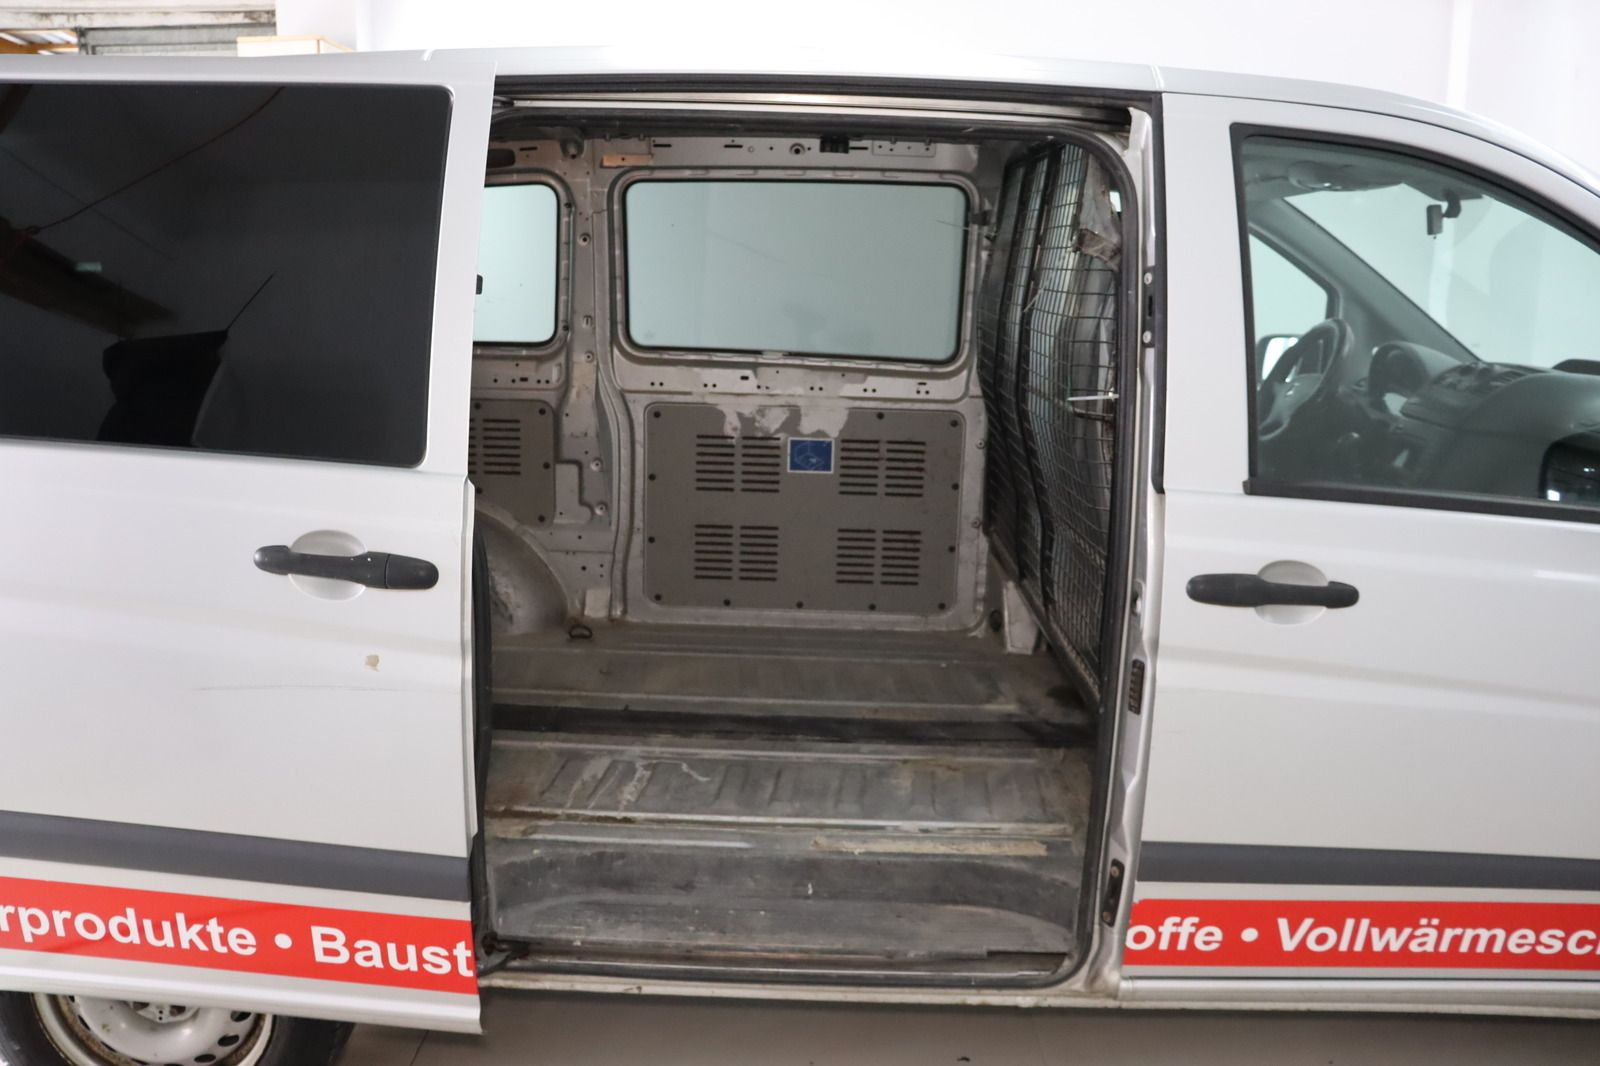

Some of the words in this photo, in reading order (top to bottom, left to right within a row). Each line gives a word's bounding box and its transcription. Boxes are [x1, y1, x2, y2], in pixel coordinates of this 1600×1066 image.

[0, 904, 258, 956] rprodukte
[311, 925, 474, 977] Baust
[1125, 916, 1224, 952] offe
[1277, 918, 1600, 956] Vollwärmesc
